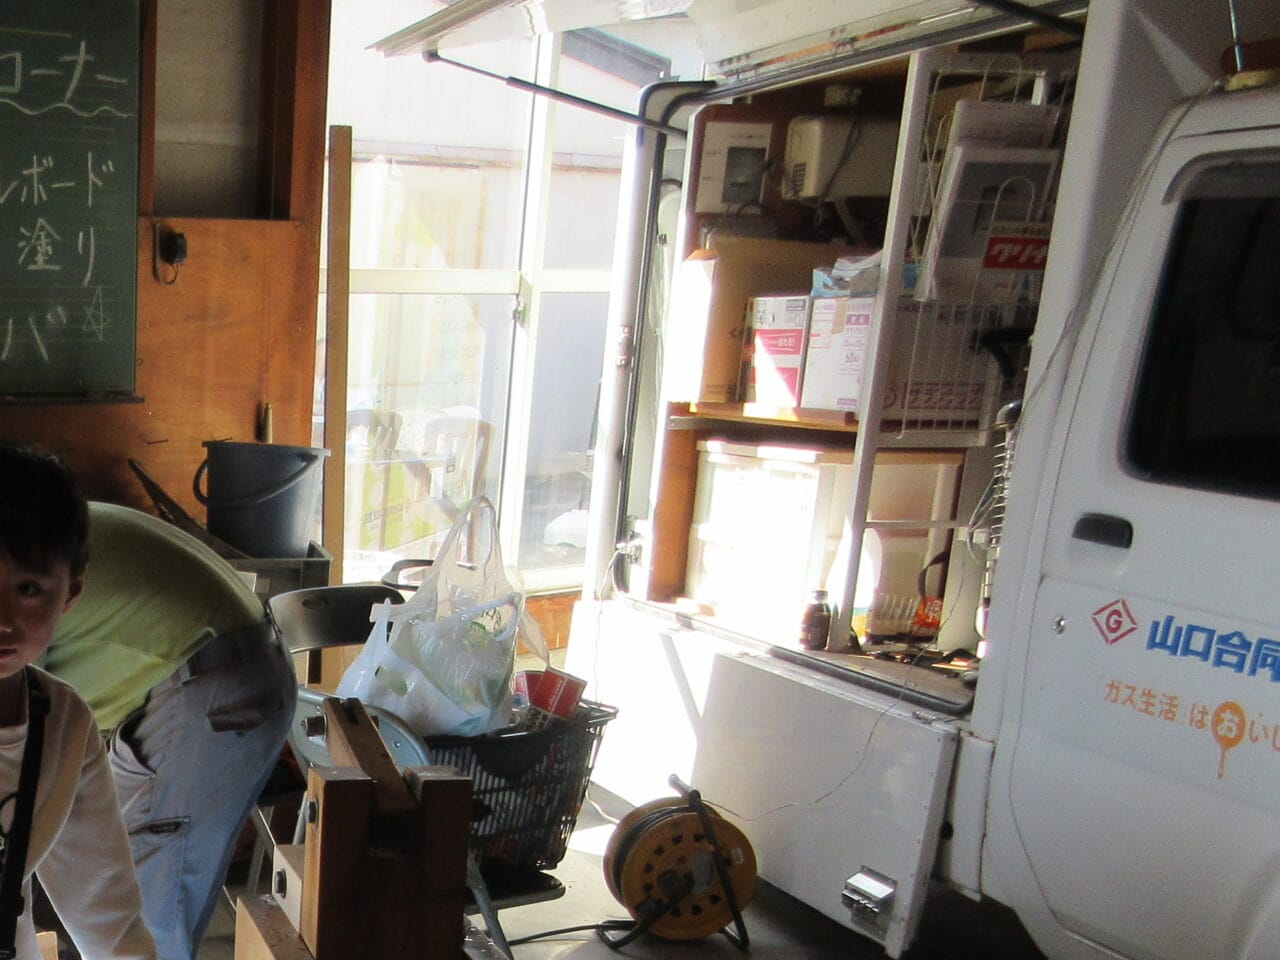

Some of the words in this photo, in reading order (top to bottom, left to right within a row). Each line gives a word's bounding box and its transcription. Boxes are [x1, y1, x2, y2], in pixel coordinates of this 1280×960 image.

[1104, 608, 1124, 634] G
[1145, 615, 1280, 682] 山口合同
